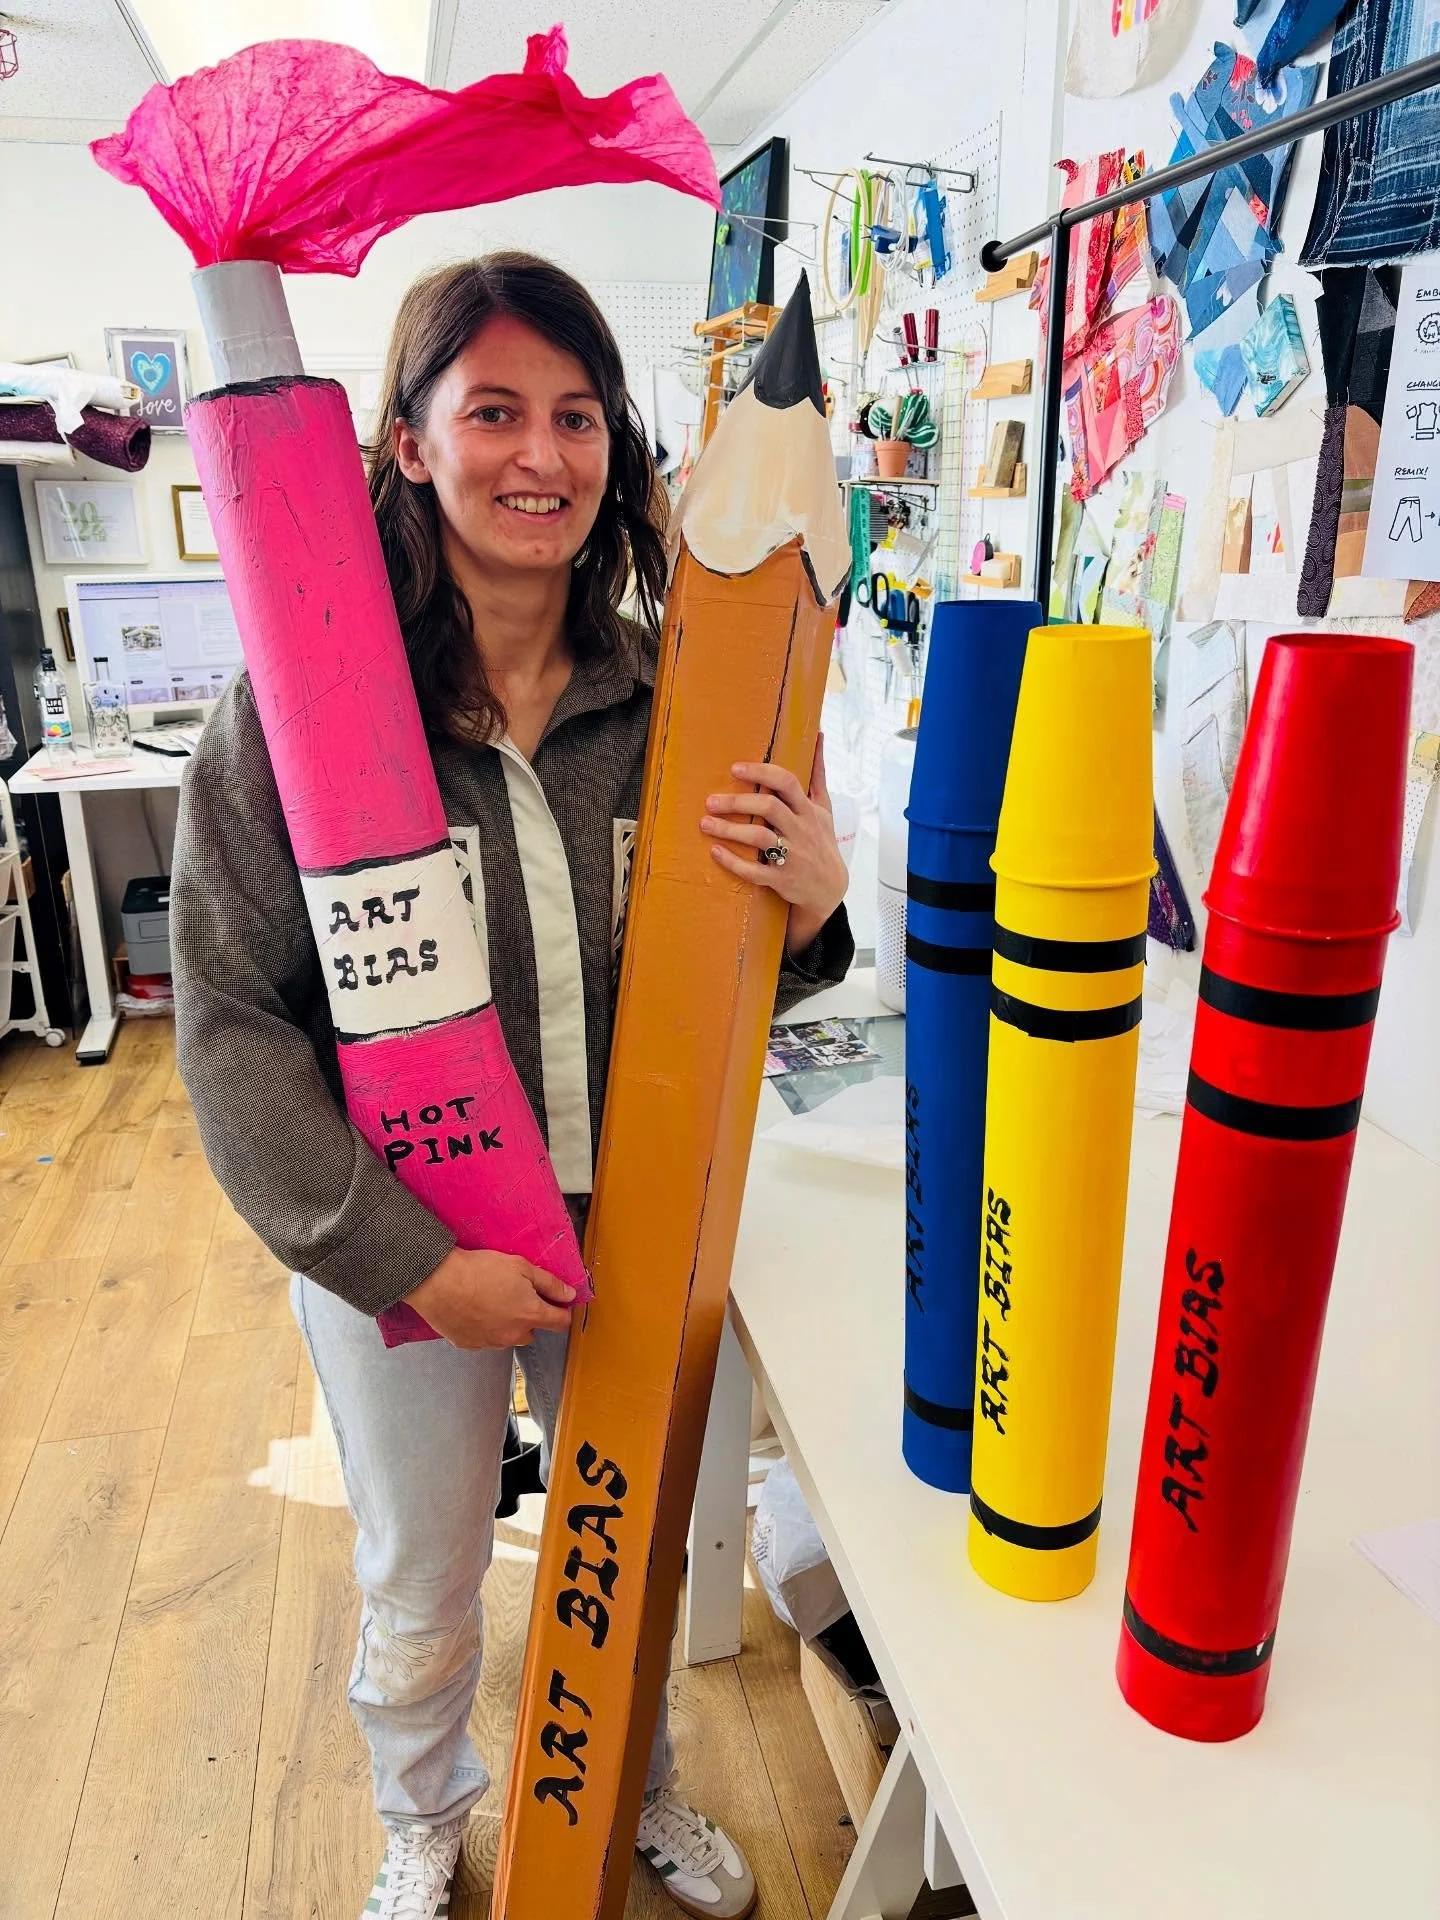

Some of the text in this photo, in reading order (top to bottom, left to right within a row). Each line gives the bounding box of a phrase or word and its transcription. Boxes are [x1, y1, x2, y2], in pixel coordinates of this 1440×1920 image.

[1416, 288, 1440, 298] EMB
[1407, 380, 1440, 388] CHANG
[1395, 467, 1429, 476] REMIX!
[329, 884, 420, 934] ART
[334, 939, 438, 990] BIAS
[380, 1096, 475, 1134] HOT
[384, 1126, 504, 1172] PINK
[980, 1186, 1012, 1435] ART BIAS
[1162, 1247, 1225, 1533] ART BIAS
[533, 1440, 628, 1827] ART BIAS
